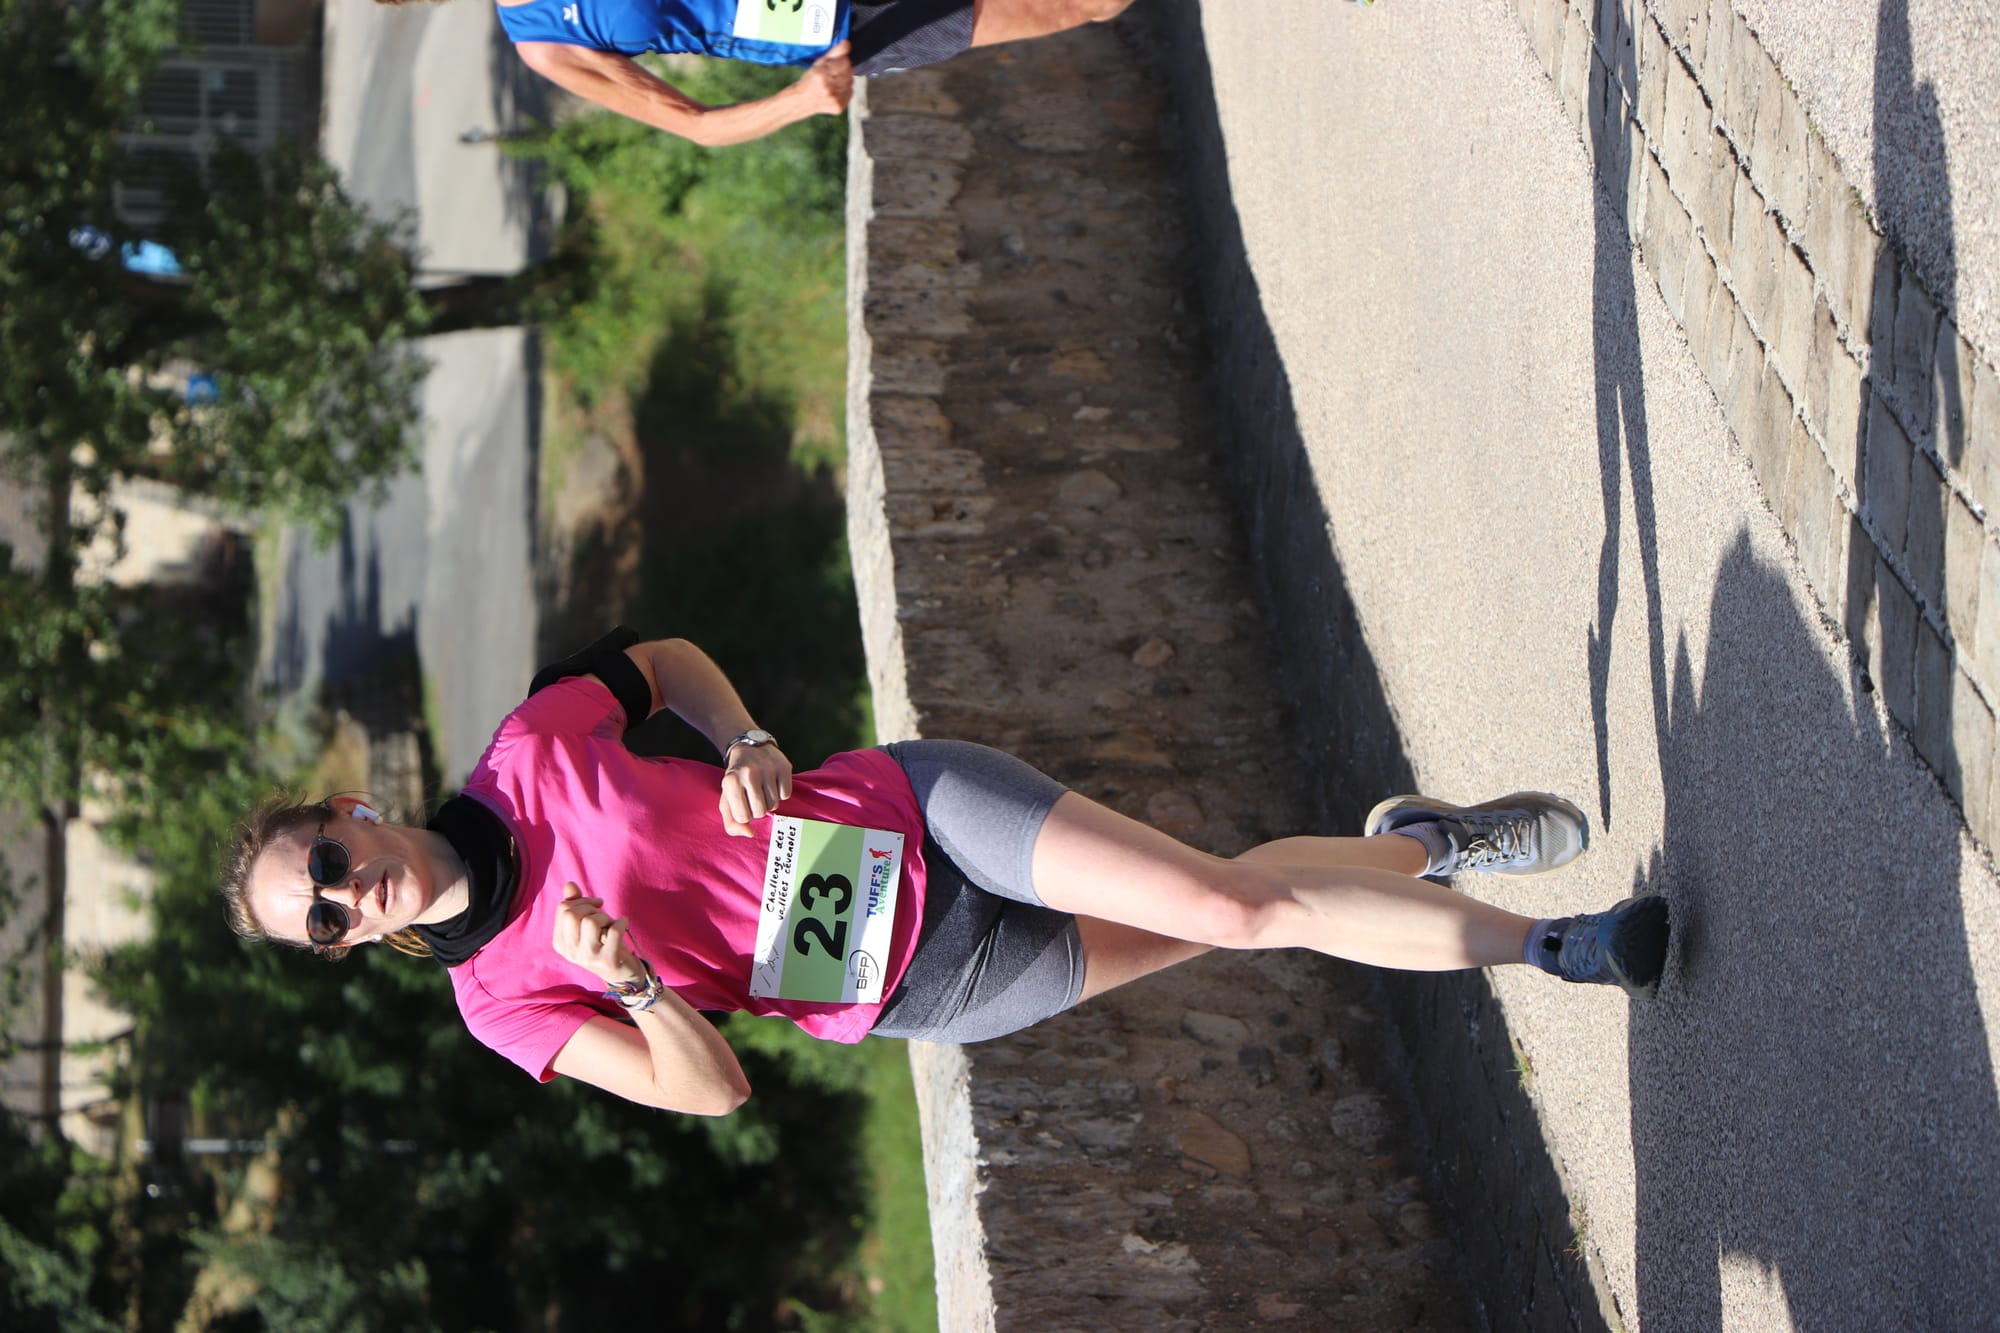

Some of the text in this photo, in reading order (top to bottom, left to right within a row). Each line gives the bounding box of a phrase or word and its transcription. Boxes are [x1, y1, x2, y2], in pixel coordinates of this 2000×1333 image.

[766, 829, 785, 913] Challenge des
[776, 825, 797, 920] vallées cévenoles
[866, 865, 882, 918] TUFF'S
[876, 860, 892, 914] Aventure
[793, 873, 853, 961] 23
[856, 956, 870, 990] BFP
